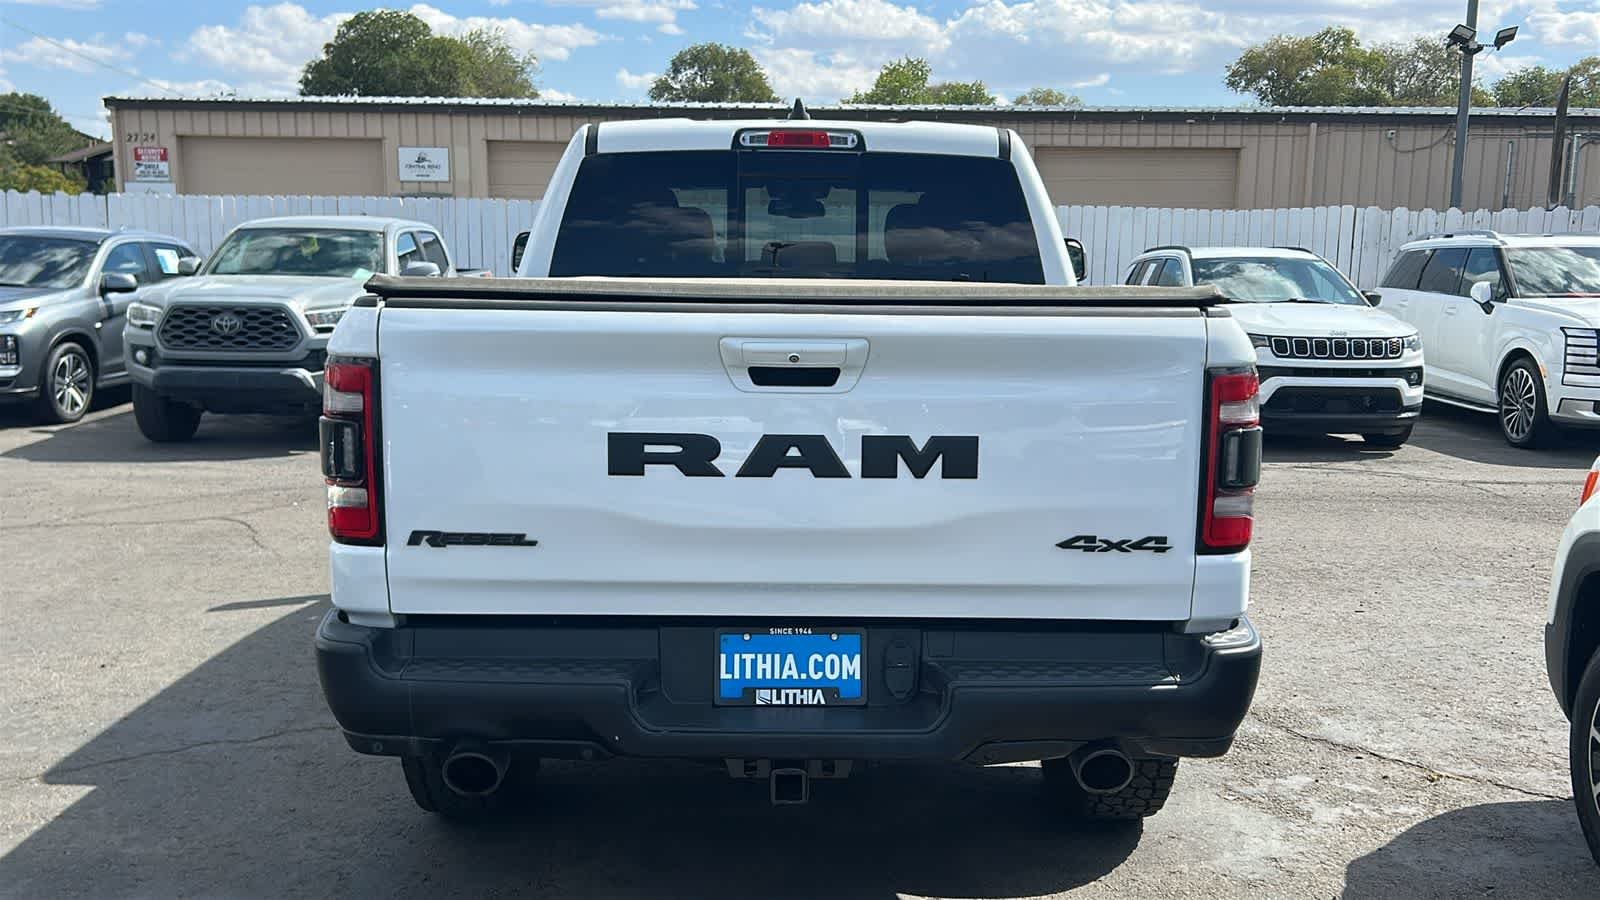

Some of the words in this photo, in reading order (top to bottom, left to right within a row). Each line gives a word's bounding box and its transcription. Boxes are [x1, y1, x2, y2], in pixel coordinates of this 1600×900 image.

[608, 432, 979, 480] RAM
[1055, 535, 1174, 553] 4x4
[769, 627, 793, 635] SINCE
[795, 627, 813, 635] 1946
[720, 653, 861, 680] LITHIA.COM
[771, 689, 826, 705] LITHIA
